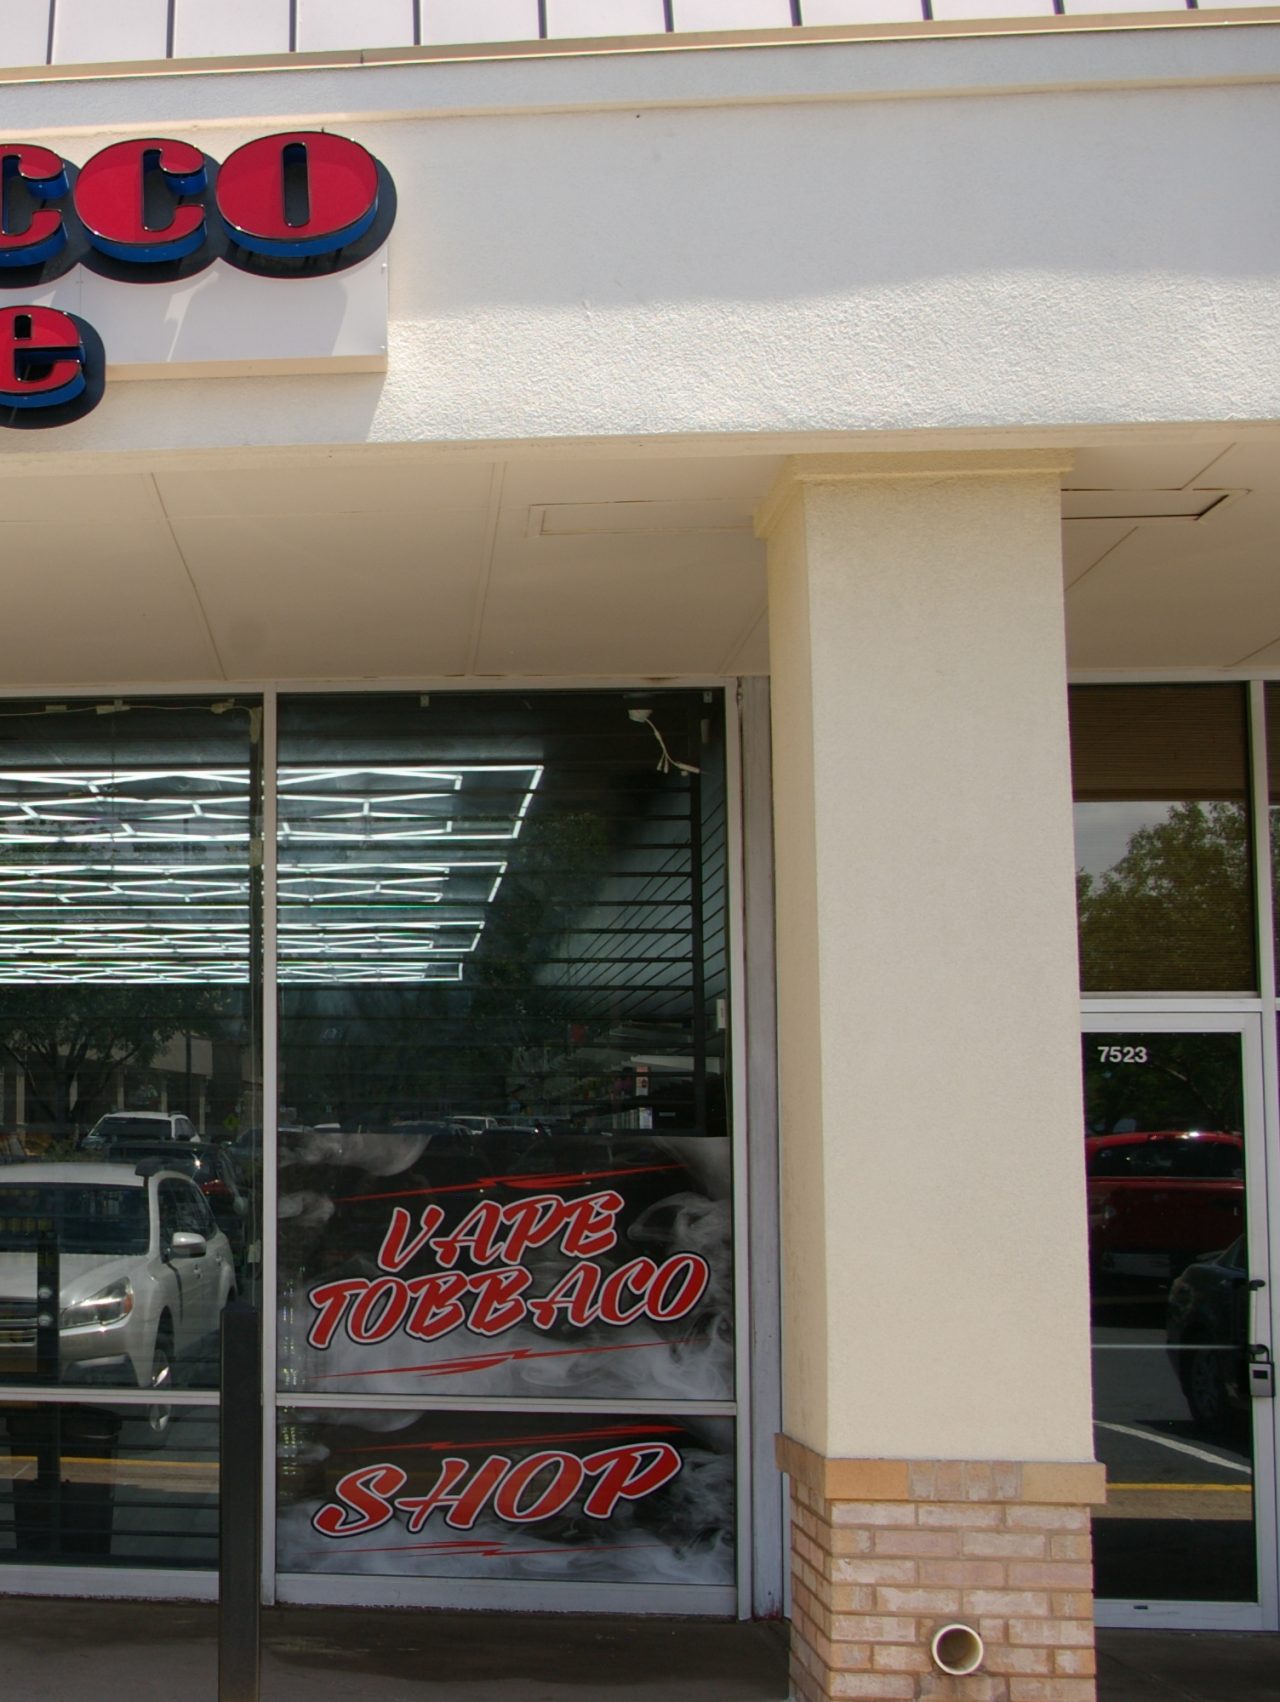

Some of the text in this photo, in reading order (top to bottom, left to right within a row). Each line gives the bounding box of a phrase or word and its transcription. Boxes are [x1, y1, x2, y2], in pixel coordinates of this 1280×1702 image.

[1097, 1046, 1148, 1063] 7523
[376, 1190, 625, 1273] VAPE
[307, 1252, 712, 1350] TOBBACO
[310, 1442, 686, 1538] SHOP
